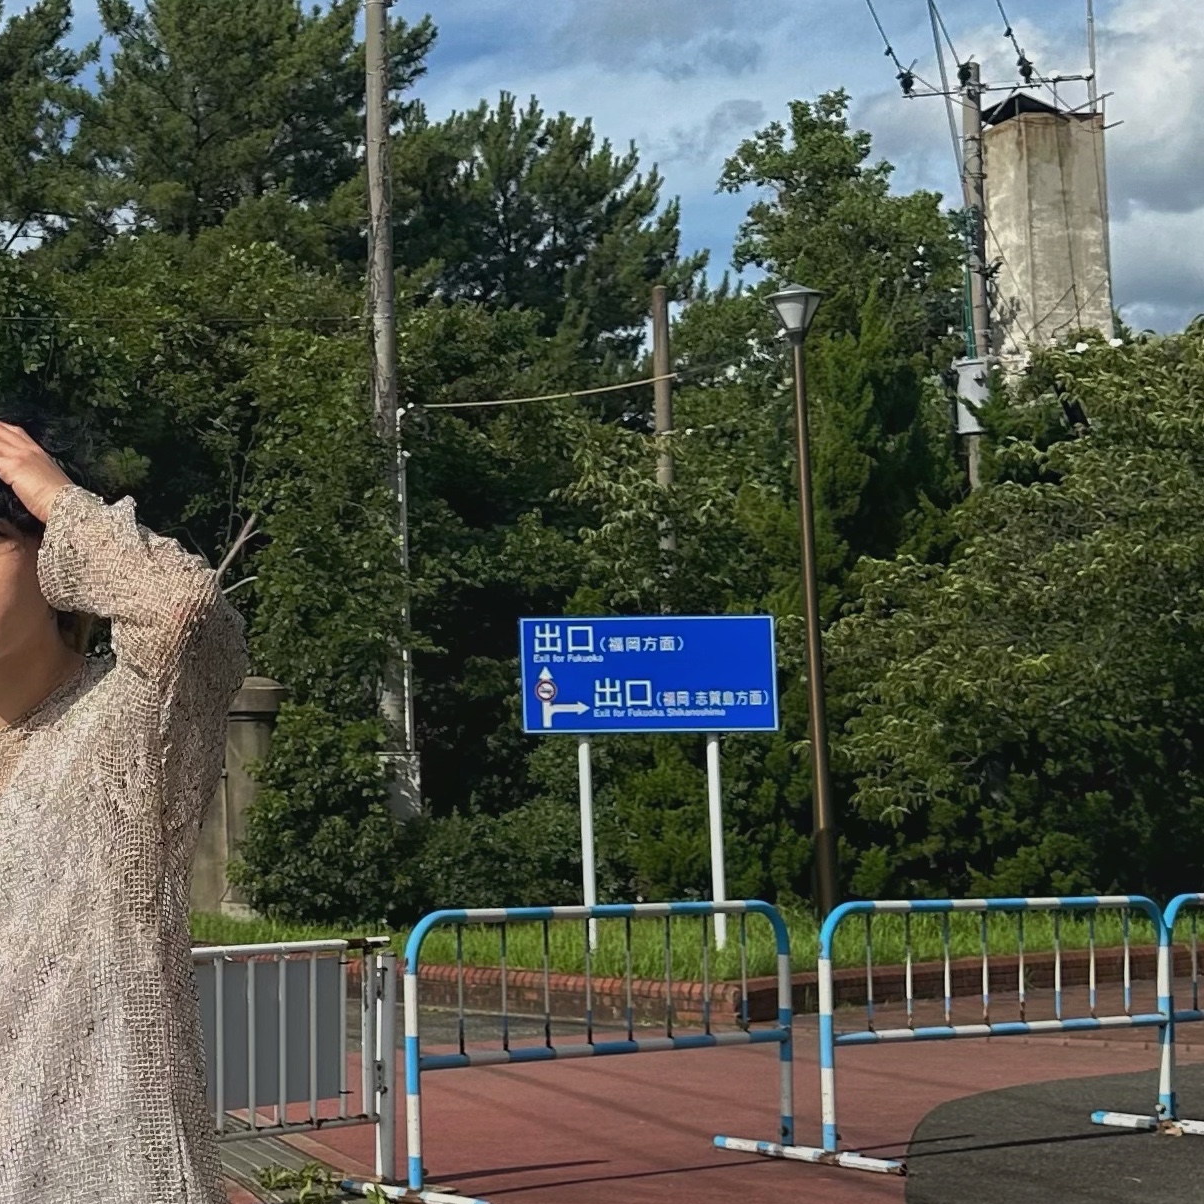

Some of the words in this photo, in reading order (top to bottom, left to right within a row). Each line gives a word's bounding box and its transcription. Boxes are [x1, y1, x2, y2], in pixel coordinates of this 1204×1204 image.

[534, 623, 594, 652] 出口
[533, 653, 551, 663] Exit
[594, 677, 652, 707] 出口
[593, 708, 611, 718] Exit
